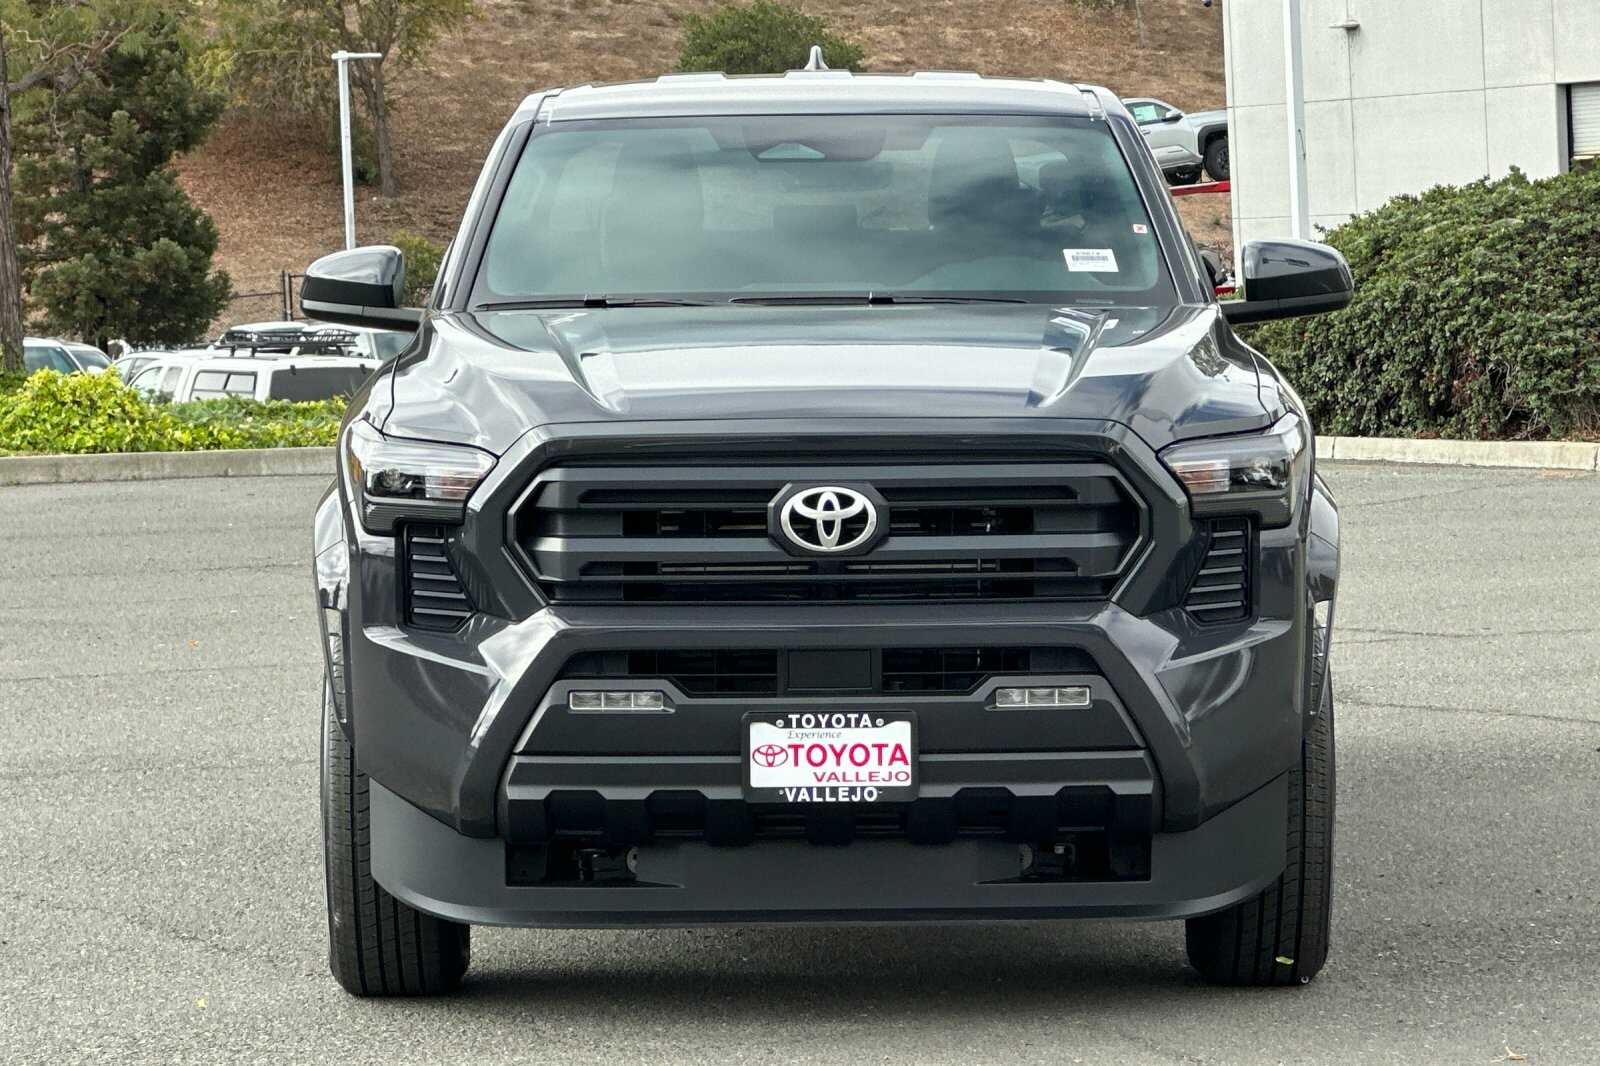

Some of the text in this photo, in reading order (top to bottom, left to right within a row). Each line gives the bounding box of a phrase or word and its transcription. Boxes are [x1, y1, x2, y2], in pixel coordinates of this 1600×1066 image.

[788, 714, 872, 728] TOYOTA
[787, 730, 842, 741] Experience
[787, 744, 909, 767] TOYOTA
[813, 771, 910, 782] VALLEJO
[785, 787, 878, 802] VALLEJO
